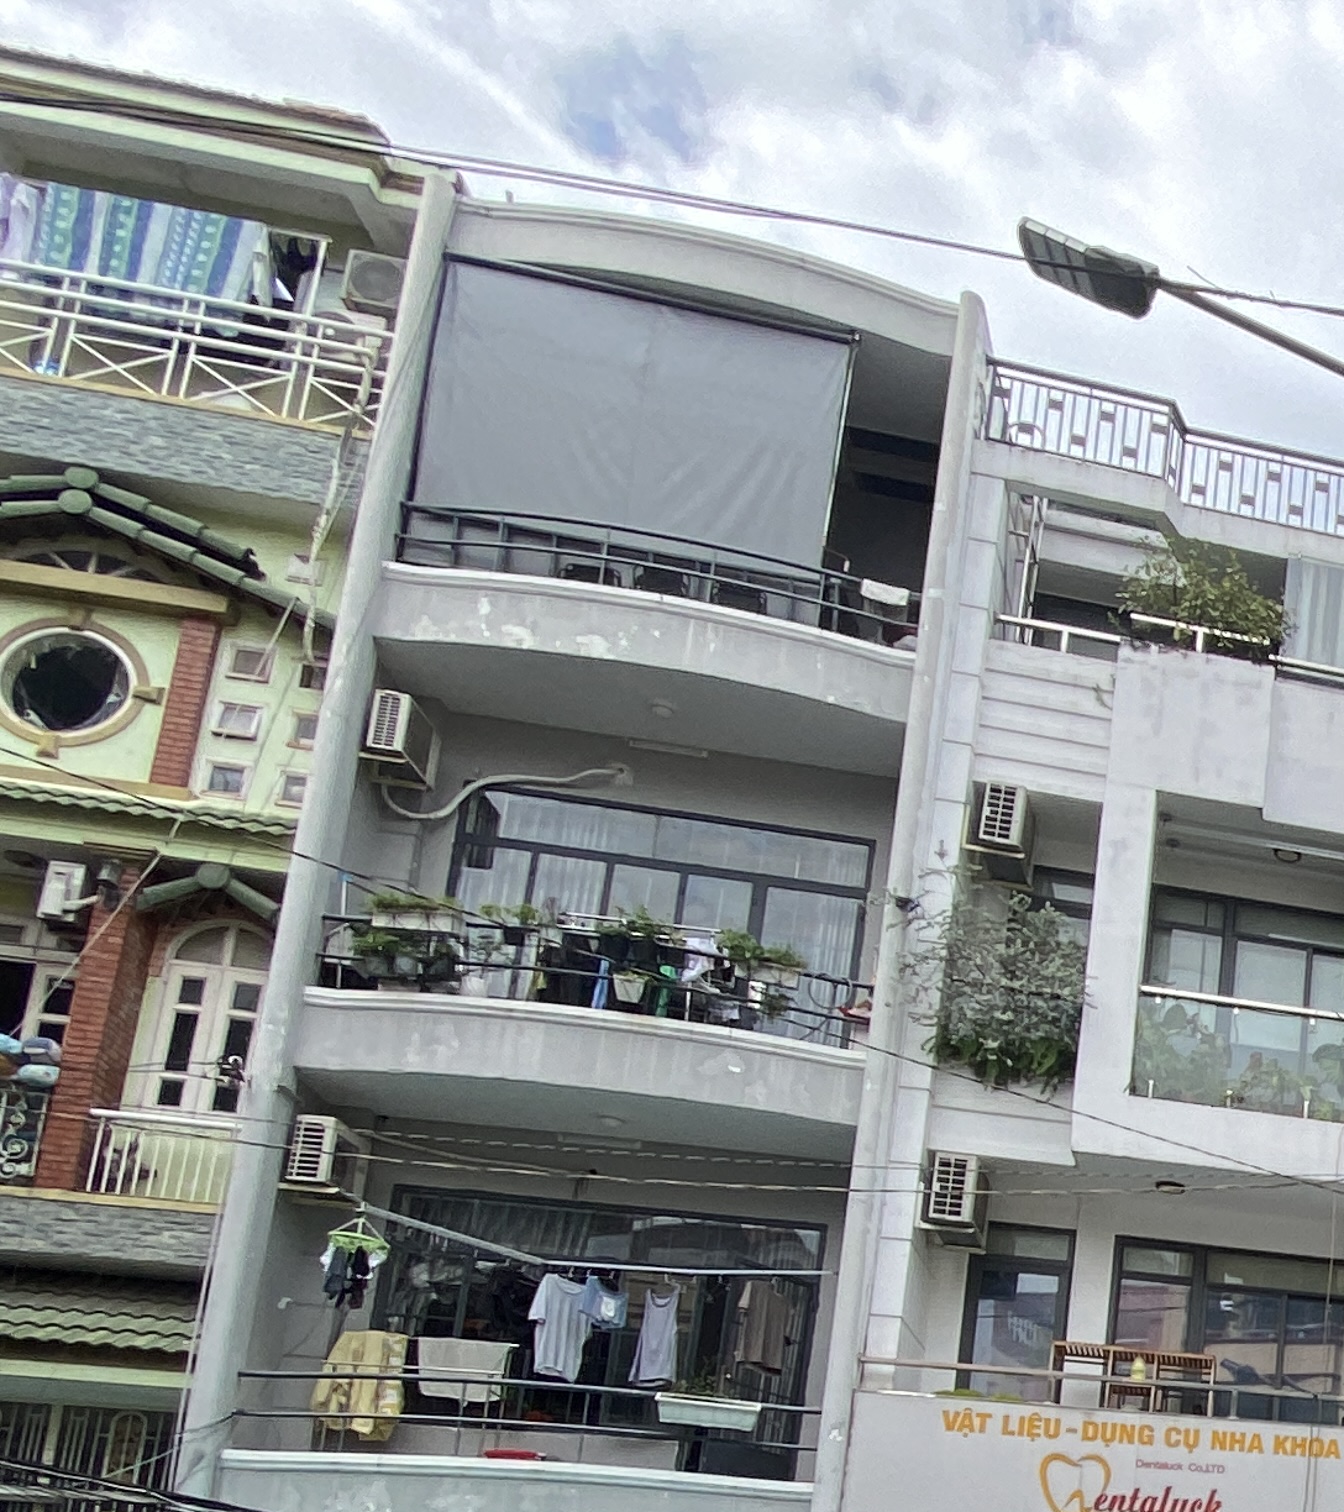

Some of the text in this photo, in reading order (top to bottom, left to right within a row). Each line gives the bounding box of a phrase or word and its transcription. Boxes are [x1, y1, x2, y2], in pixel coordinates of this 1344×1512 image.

[942, 1408, 992, 1438] VẬT
[1001, 1412, 1062, 1442] LIỆU
[1081, 1419, 1155, 1447] DỤNG
[1164, 1425, 1201, 1454] CỤ
[1210, 1431, 1265, 1455] NHA
[1273, 1435, 1342, 1460] KHOA
